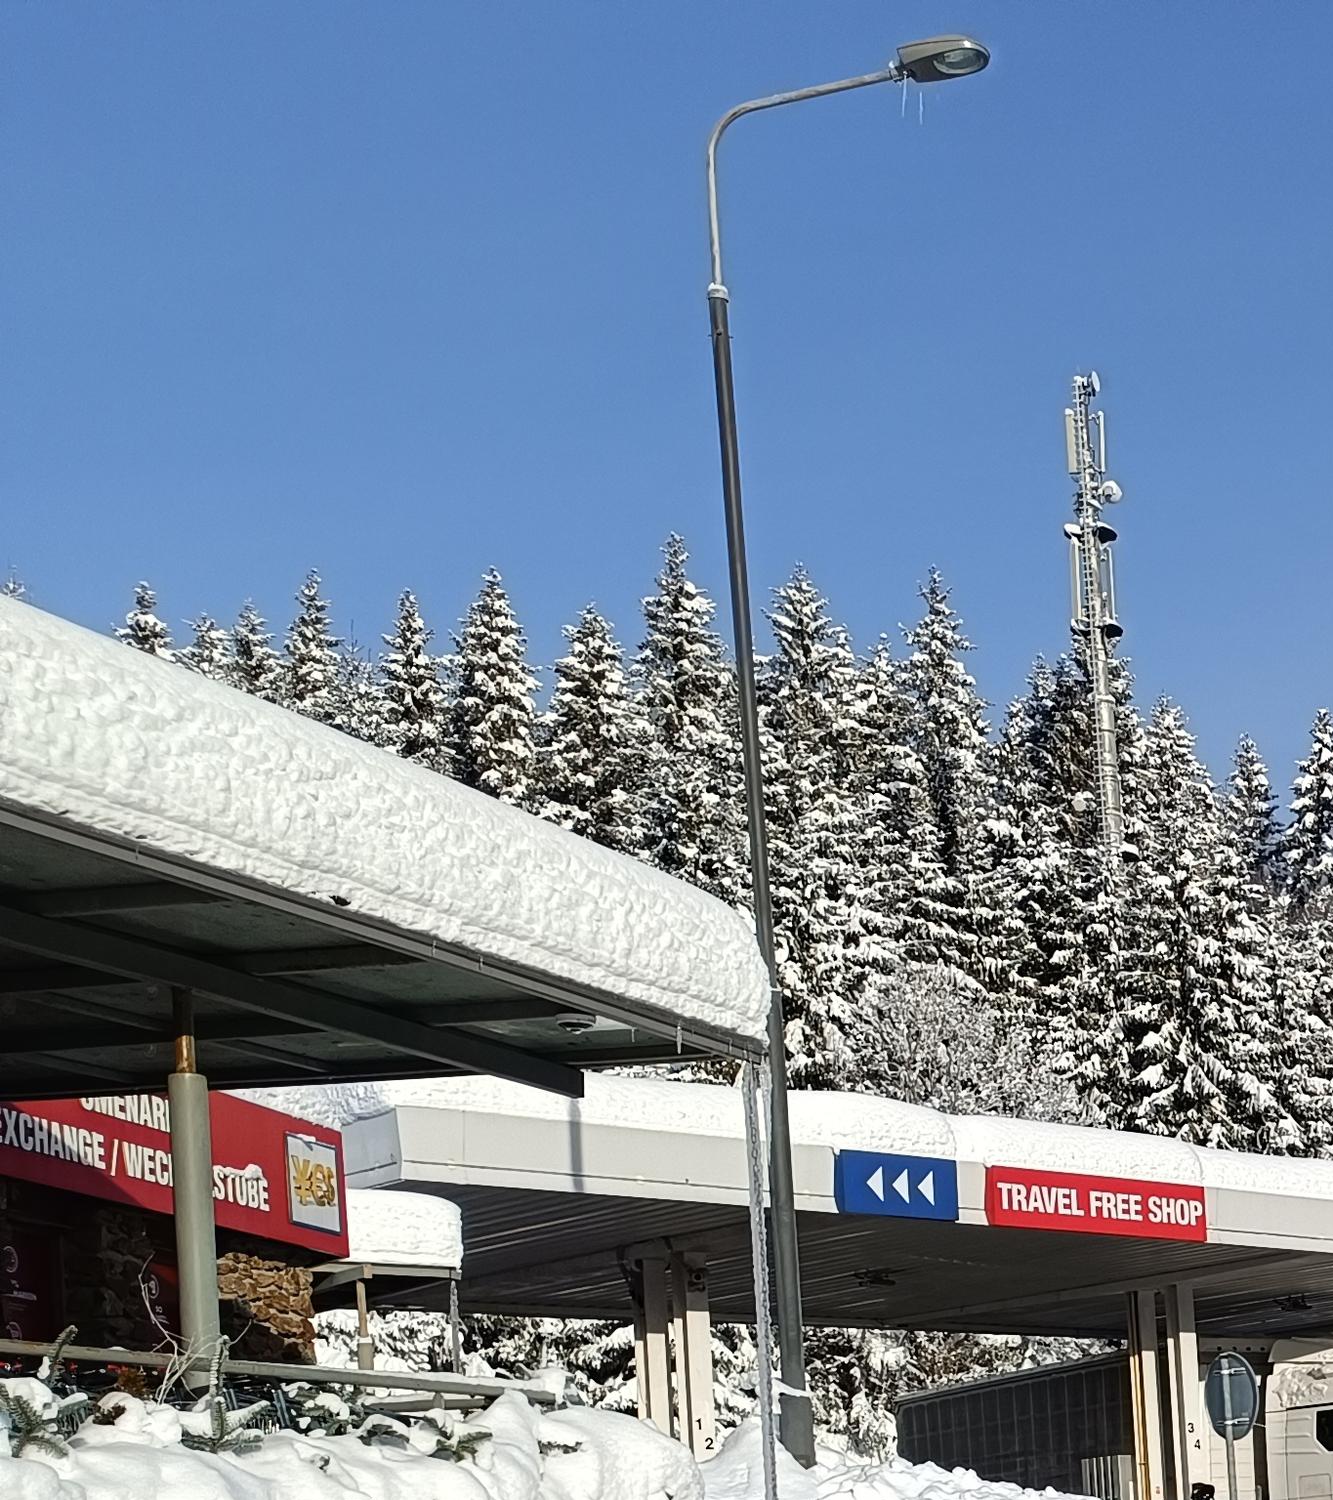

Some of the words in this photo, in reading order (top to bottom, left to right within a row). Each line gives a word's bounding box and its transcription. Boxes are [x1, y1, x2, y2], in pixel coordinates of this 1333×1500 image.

[0, 1108, 106, 1169] XCHANGE
[996, 1182, 1085, 1216] TRAVEL
[1089, 1190, 1144, 1221] FREE
[1148, 1195, 1203, 1226] SHOP
[695, 1417, 702, 1430] 1
[1187, 1422, 1195, 1433] 3
[704, 1437, 715, 1450] 2
[1194, 1439, 1201, 1450] 4
